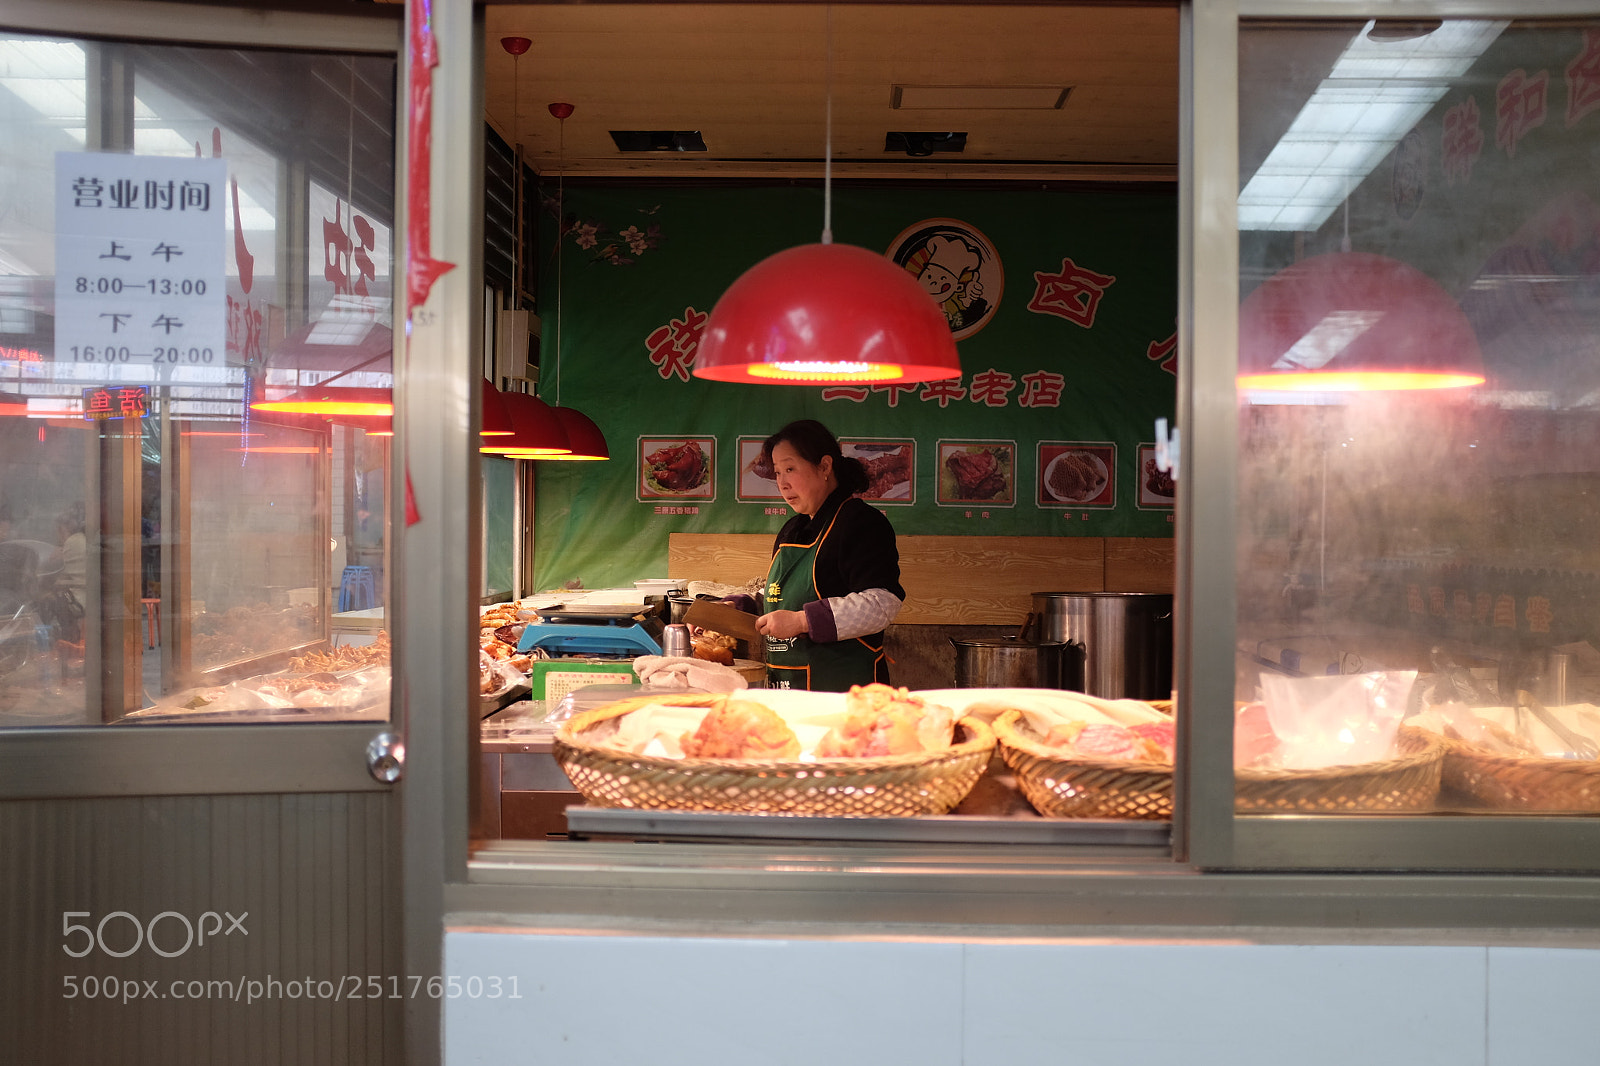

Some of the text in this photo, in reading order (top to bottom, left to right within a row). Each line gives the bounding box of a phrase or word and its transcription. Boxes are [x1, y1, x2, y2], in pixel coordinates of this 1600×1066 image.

[72, 176, 211, 212] 营业时间
[99, 241, 184, 263] 上午
[1027, 257, 1117, 329] 卤
[99, 313, 184, 335] 下午
